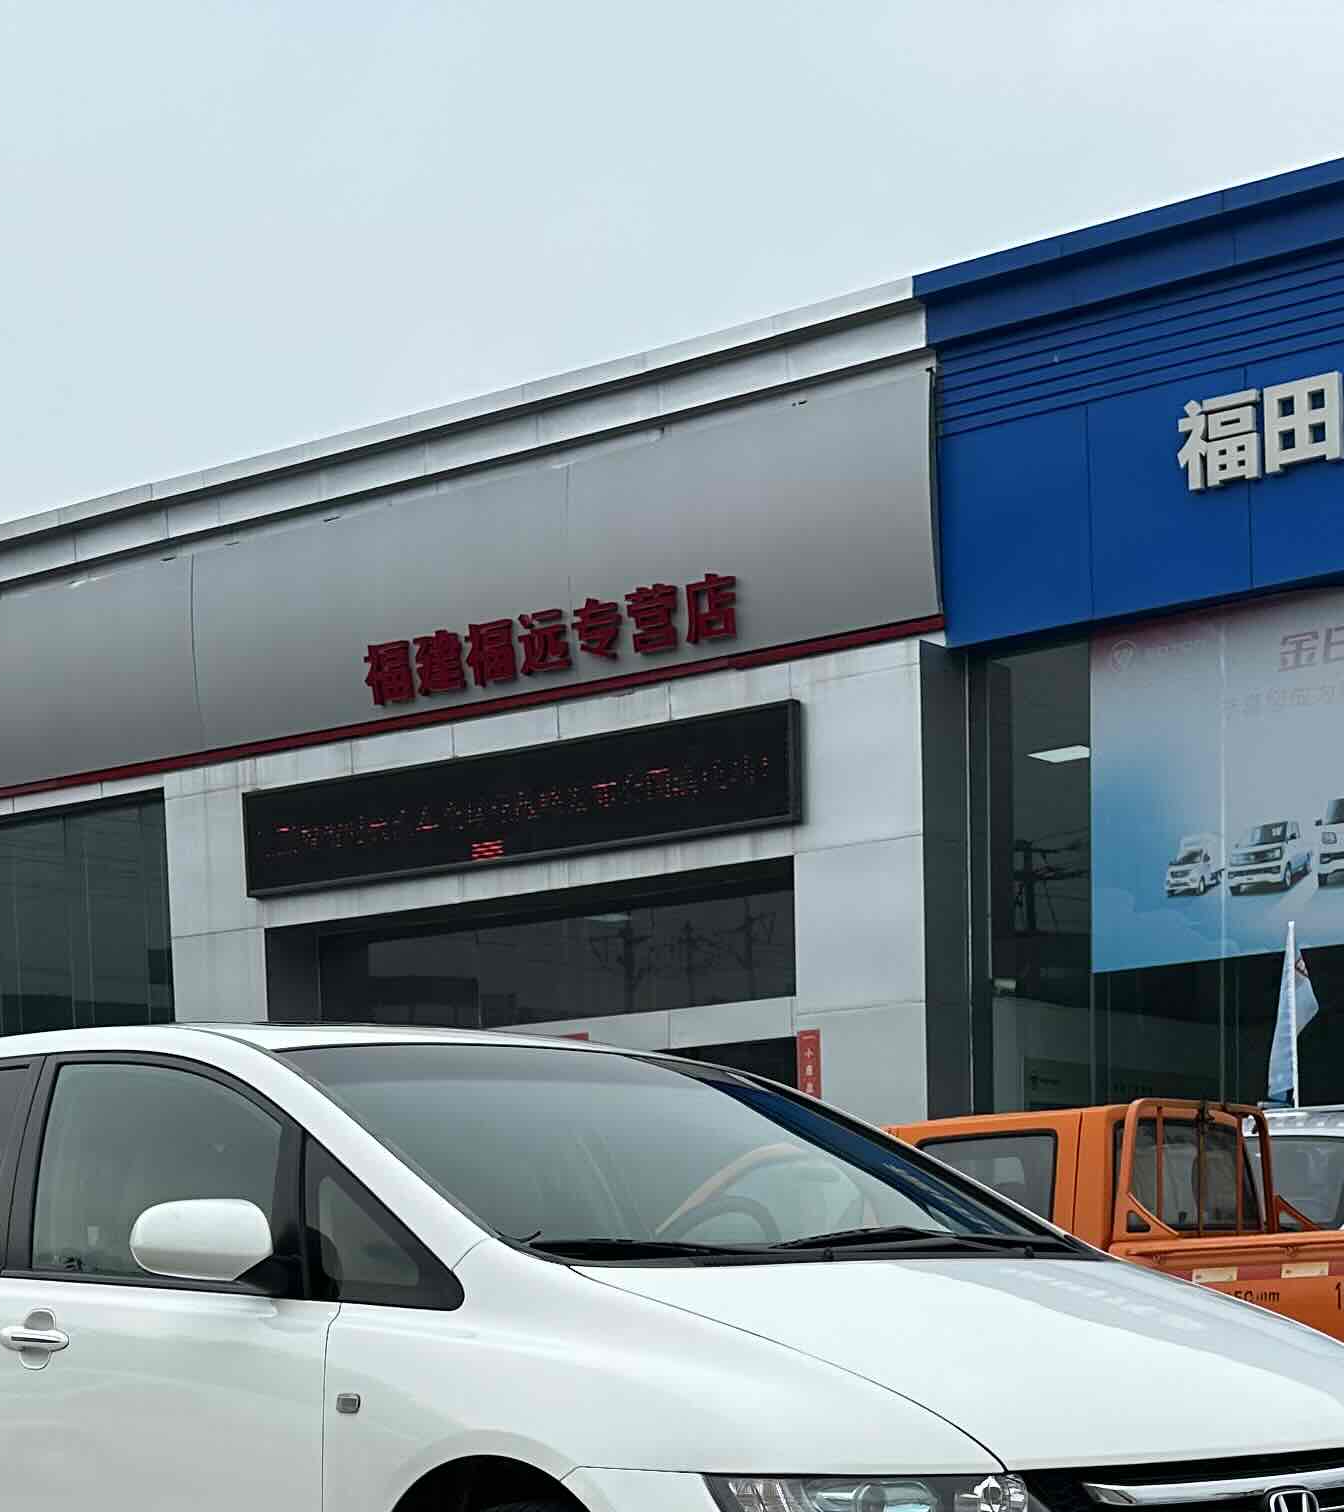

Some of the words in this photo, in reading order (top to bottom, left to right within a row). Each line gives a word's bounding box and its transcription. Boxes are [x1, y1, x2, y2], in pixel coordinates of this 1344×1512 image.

[364, 572, 740, 706] 福建福远专营店
